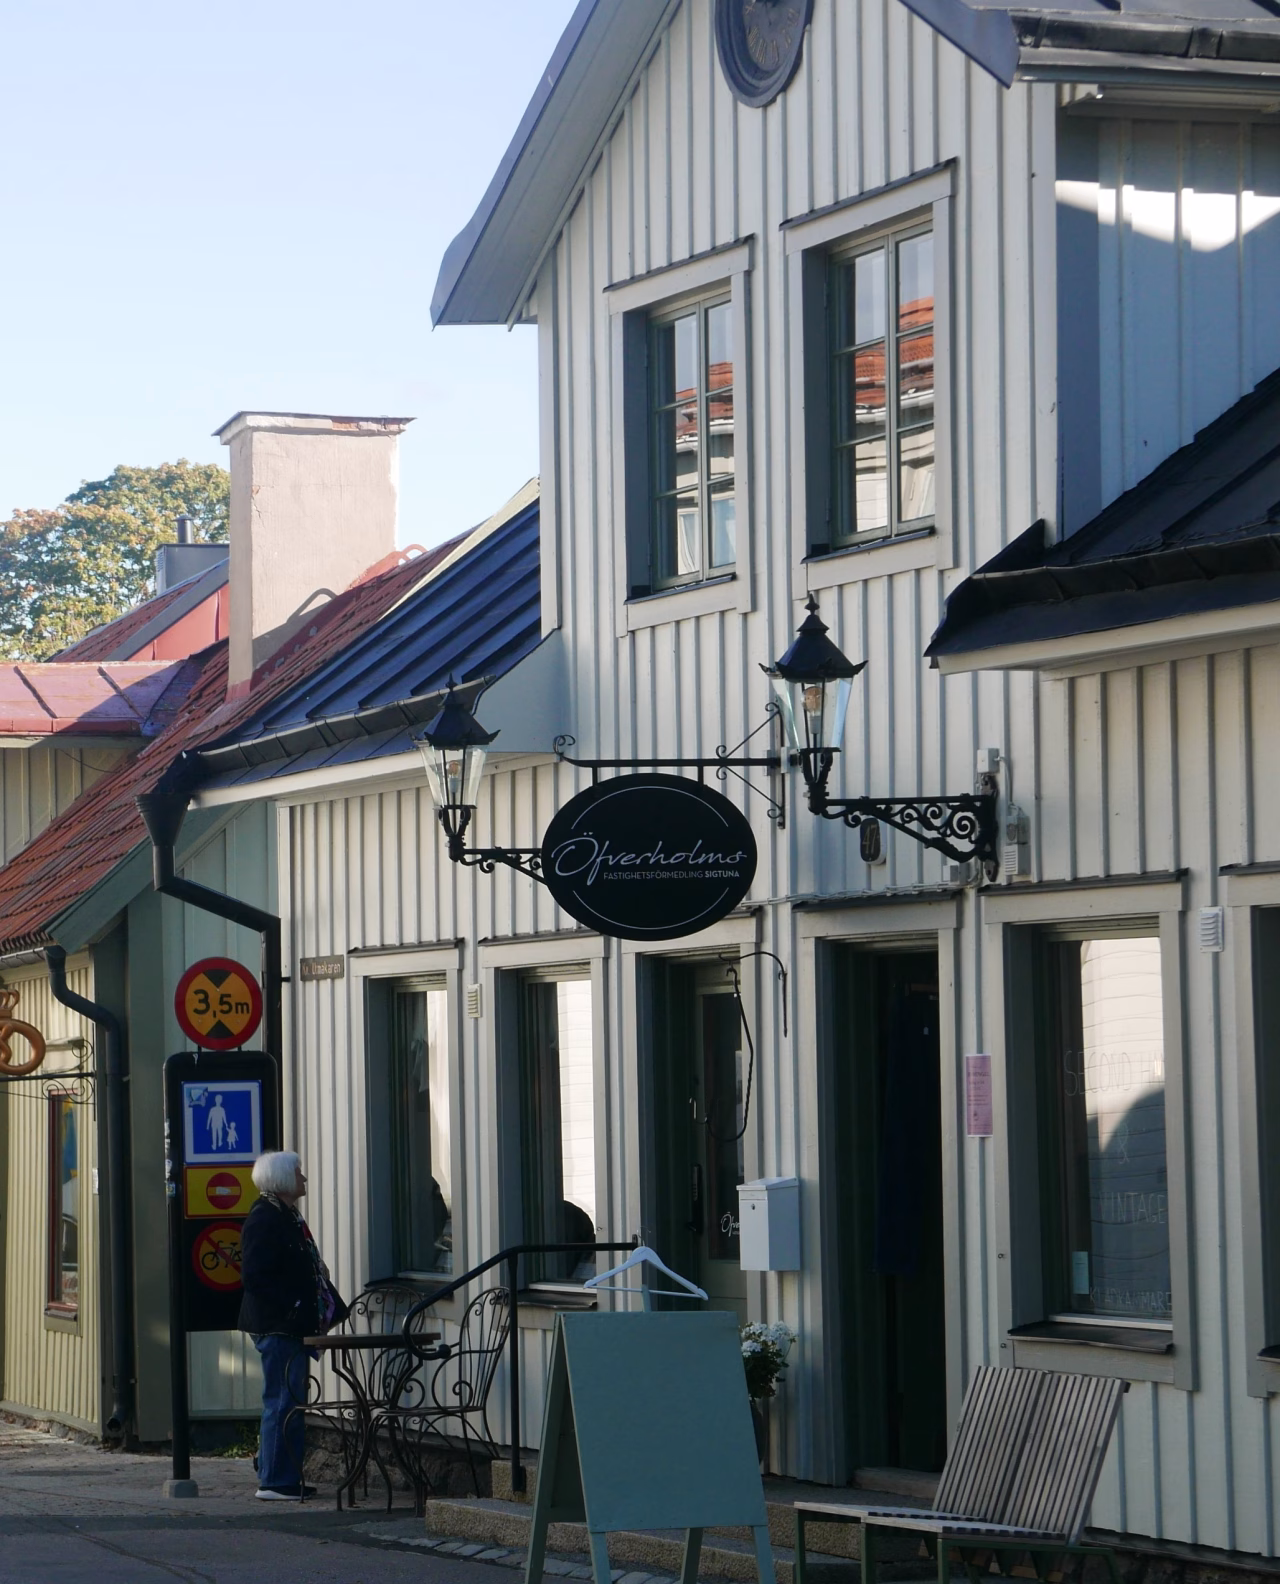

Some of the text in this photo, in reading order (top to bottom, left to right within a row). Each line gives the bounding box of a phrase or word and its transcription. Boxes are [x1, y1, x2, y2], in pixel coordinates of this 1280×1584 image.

[862, 823, 878, 855] 47
[551, 832, 748, 886] Öfverholms
[603, 869, 740, 881] FASTIGHETSFÖRMEDLING SIGTUNA
[1063, 1050, 1132, 1097] SECOND
[1099, 1191, 1166, 1225] VINTAGE
